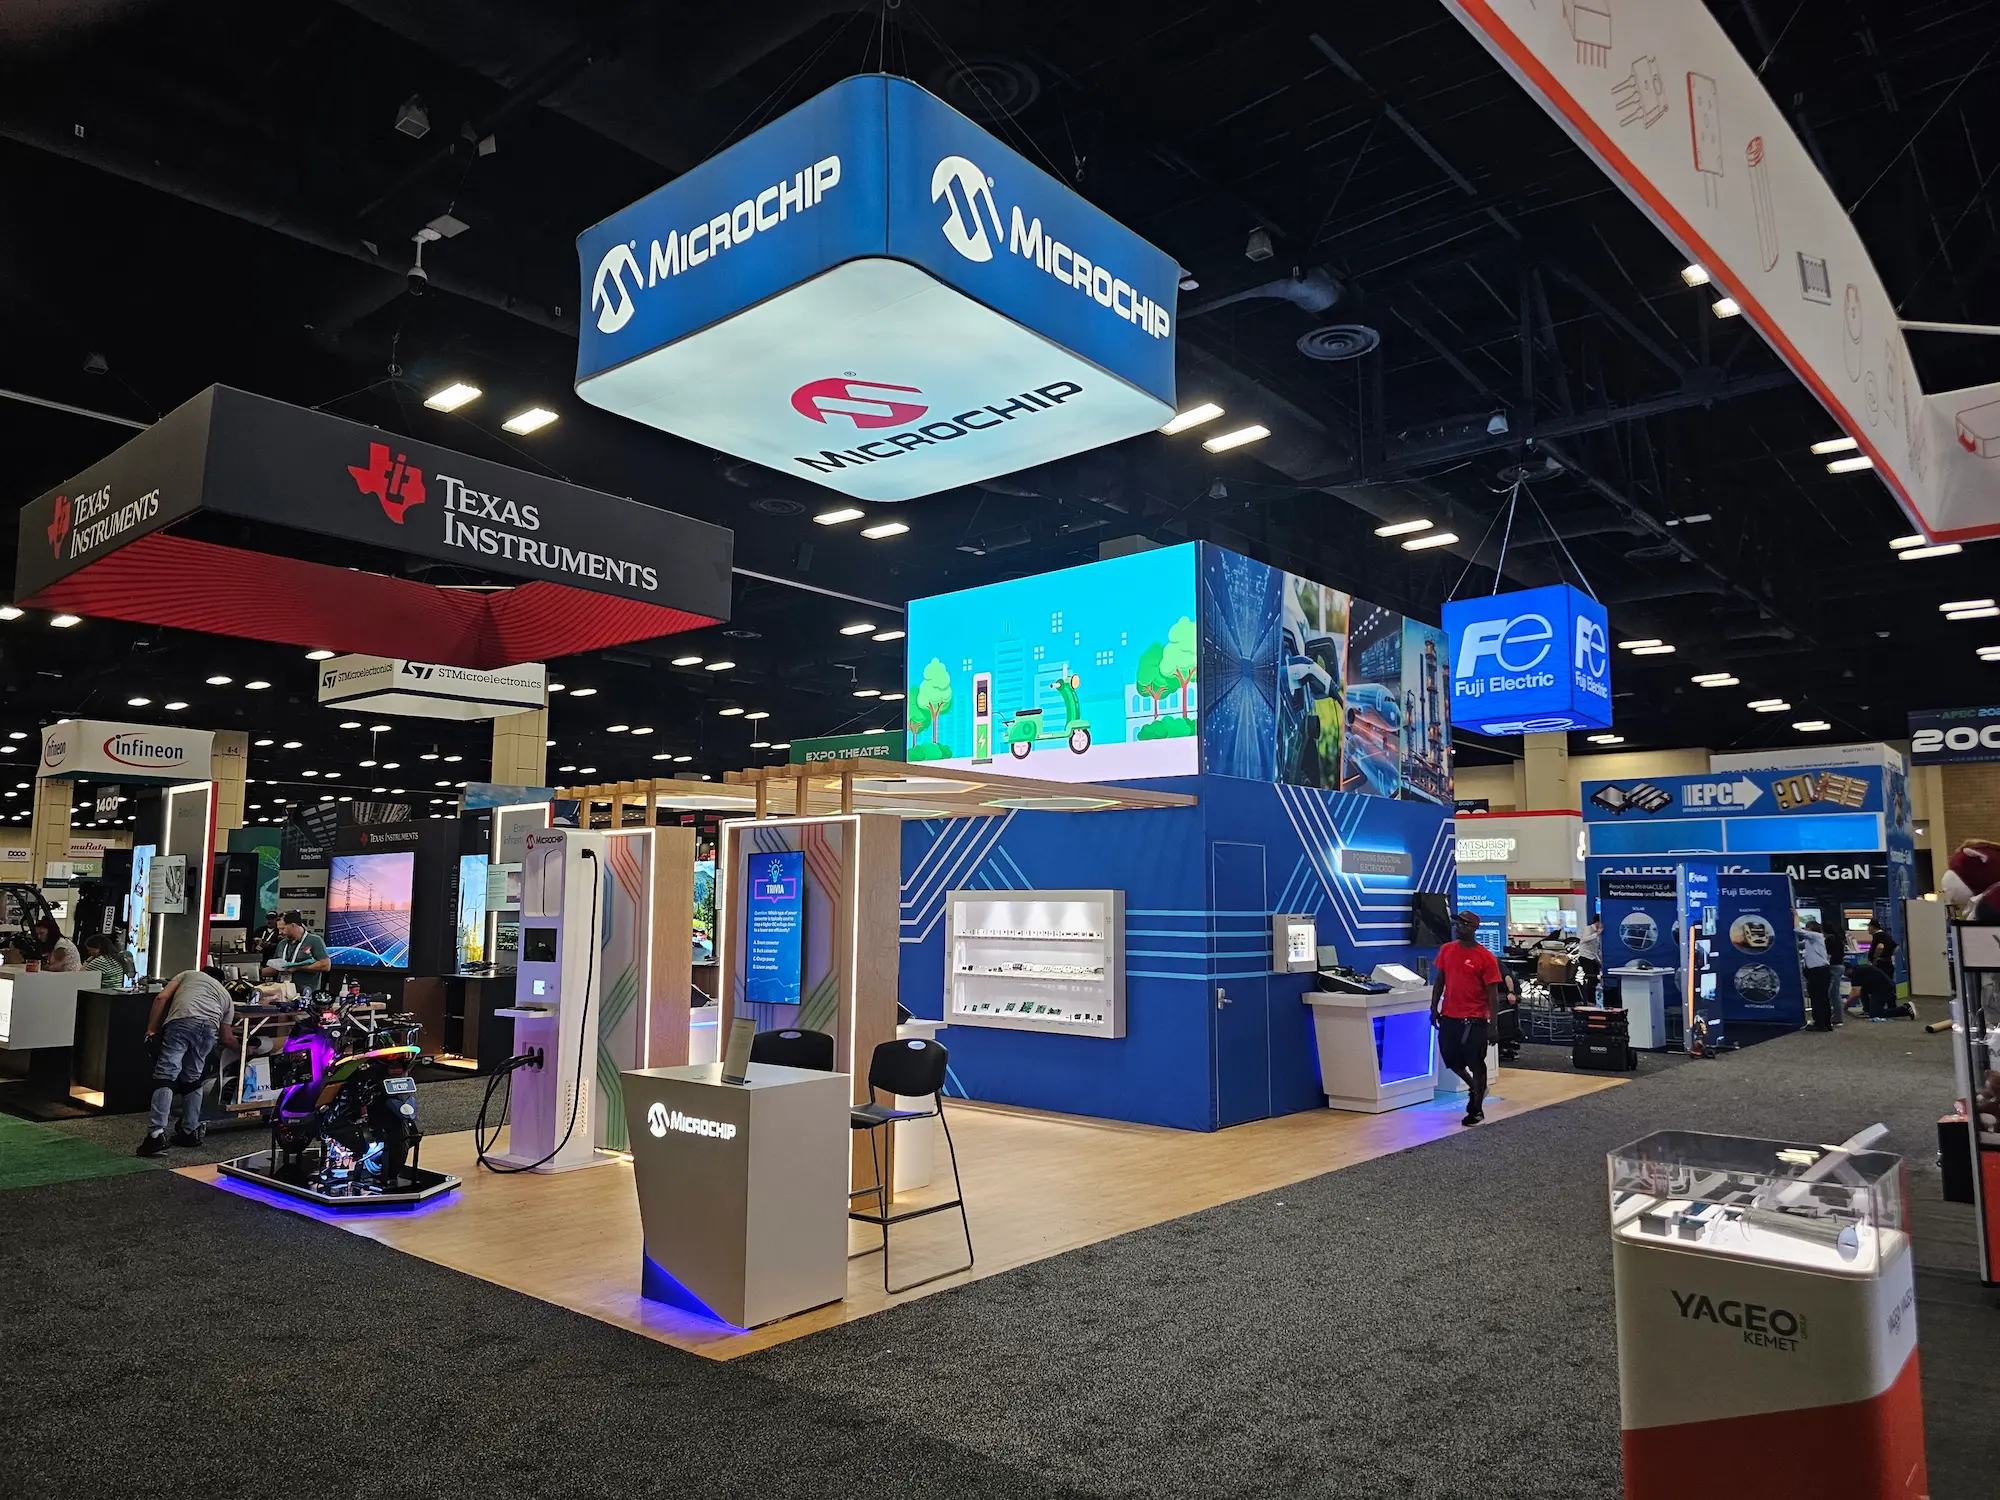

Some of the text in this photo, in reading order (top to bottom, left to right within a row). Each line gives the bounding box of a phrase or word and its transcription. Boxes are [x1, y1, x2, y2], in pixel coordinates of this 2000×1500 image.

[649, 155, 841, 288] MICROCHIP
[1010, 206, 1170, 339] MICROCHIP
[794, 381, 1083, 473] MICROCHIP
[74, 485, 111, 526] TEXAS
[436, 474, 540, 531] TEXAS
[69, 489, 160, 560] INSTRUMENTS
[443, 512, 658, 591] INSTRUMENTS
[338, 663, 393, 682] STMicroelectronics
[438, 668, 542, 689] STMicroelectronics
[1455, 672, 1554, 698] Fuji Electric
[1575, 671, 1608, 699] Fuji Electric
[115, 734, 183, 759] infineon
[805, 745, 890, 761] EXPO THEATER
[96, 796, 119, 813] 1400
[1692, 783, 1733, 805] EPC
[535, 835, 564, 845] MICROCHIP
[1458, 838, 1515, 850] MITSUBISHI
[1459, 850, 1507, 859] ELECTRIC
[766, 885, 785, 894] TRIVIA
[1721, 887, 1772, 897] Fuji Electric
[670, 1110, 737, 1140] MICROCHIP
[1669, 1287, 1799, 1337] YAGEO
[1743, 1331, 1800, 1352] KEMET
